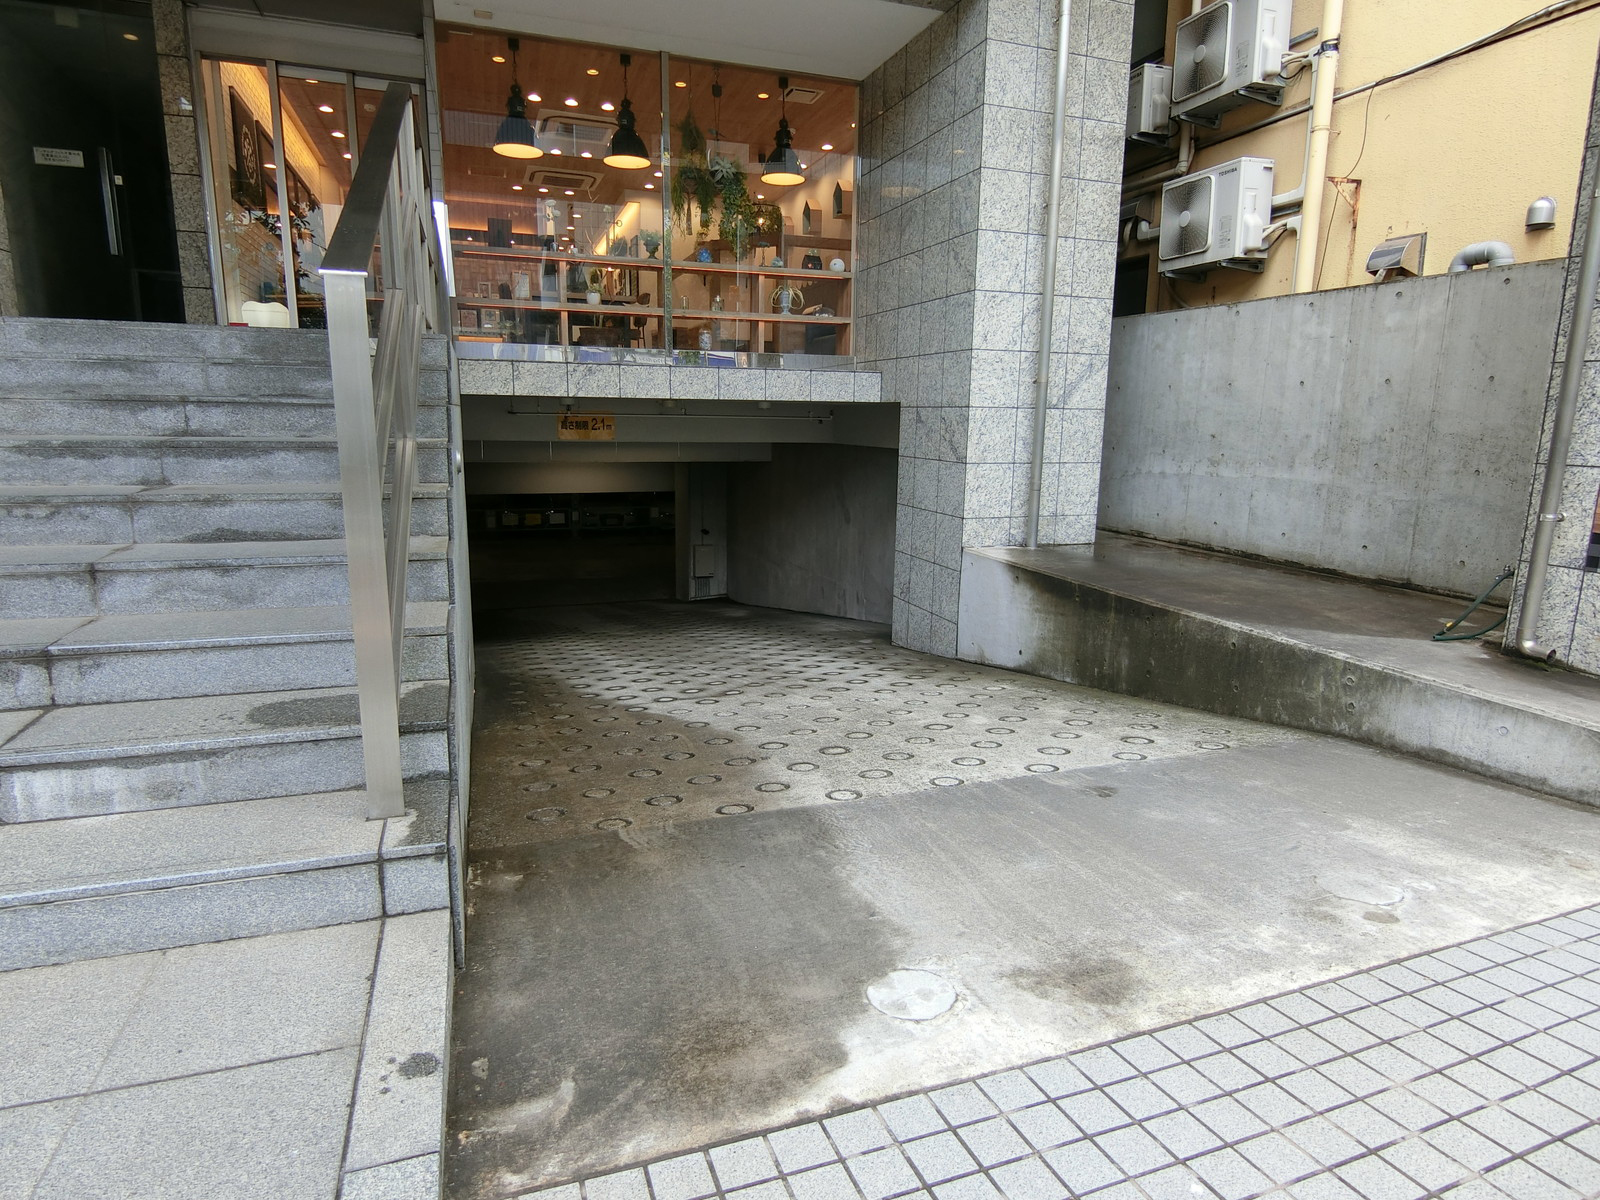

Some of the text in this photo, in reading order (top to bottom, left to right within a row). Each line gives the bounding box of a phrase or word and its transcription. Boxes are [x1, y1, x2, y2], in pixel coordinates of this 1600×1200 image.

[1218, 167, 1237, 177] TOSHIBA
[560, 420, 589, 430] 高さ制限
